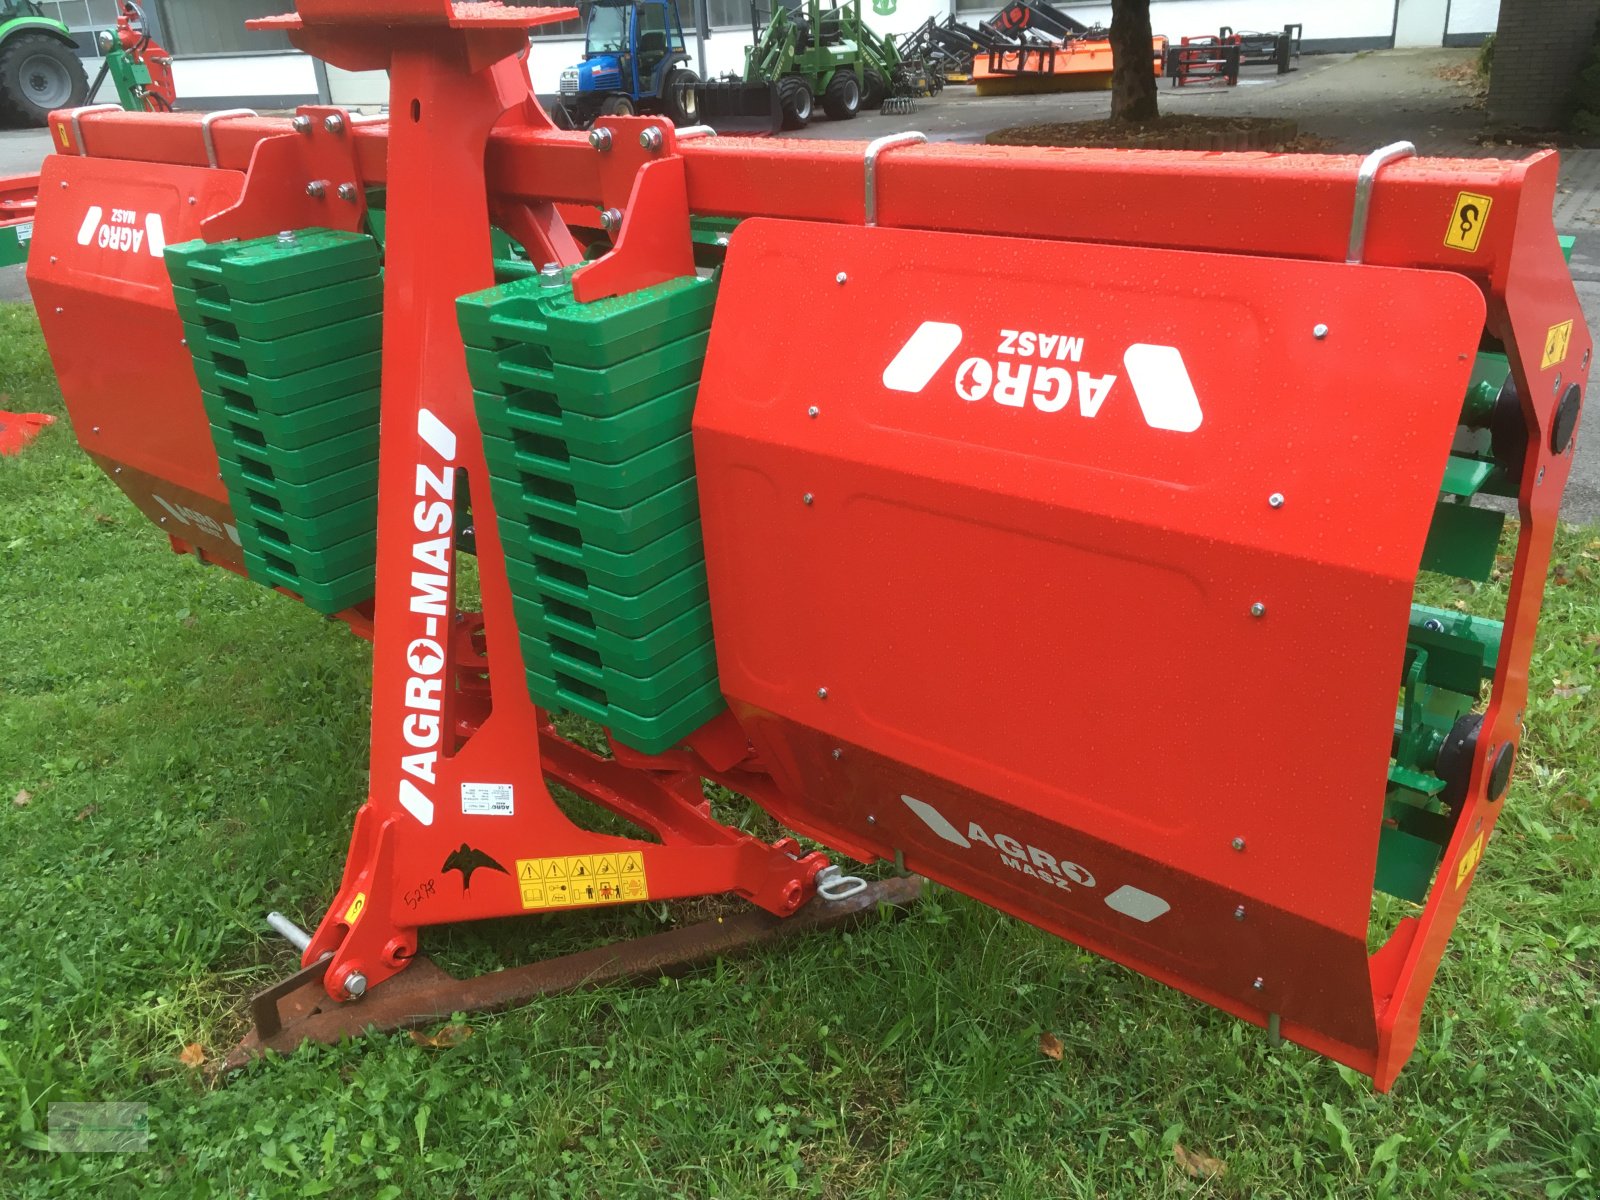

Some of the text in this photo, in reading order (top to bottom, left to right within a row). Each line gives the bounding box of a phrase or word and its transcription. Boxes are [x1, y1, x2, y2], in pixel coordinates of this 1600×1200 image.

[110, 208, 136, 224] MASZ
[98, 224, 144, 253] AGRO
[997, 329, 1085, 362] MASZ
[955, 357, 1118, 418] AGRO
[401, 463, 456, 785] AGRO-MASZ
[968, 821, 1097, 888] AGRO
[1000, 853, 1072, 893] MASZ
